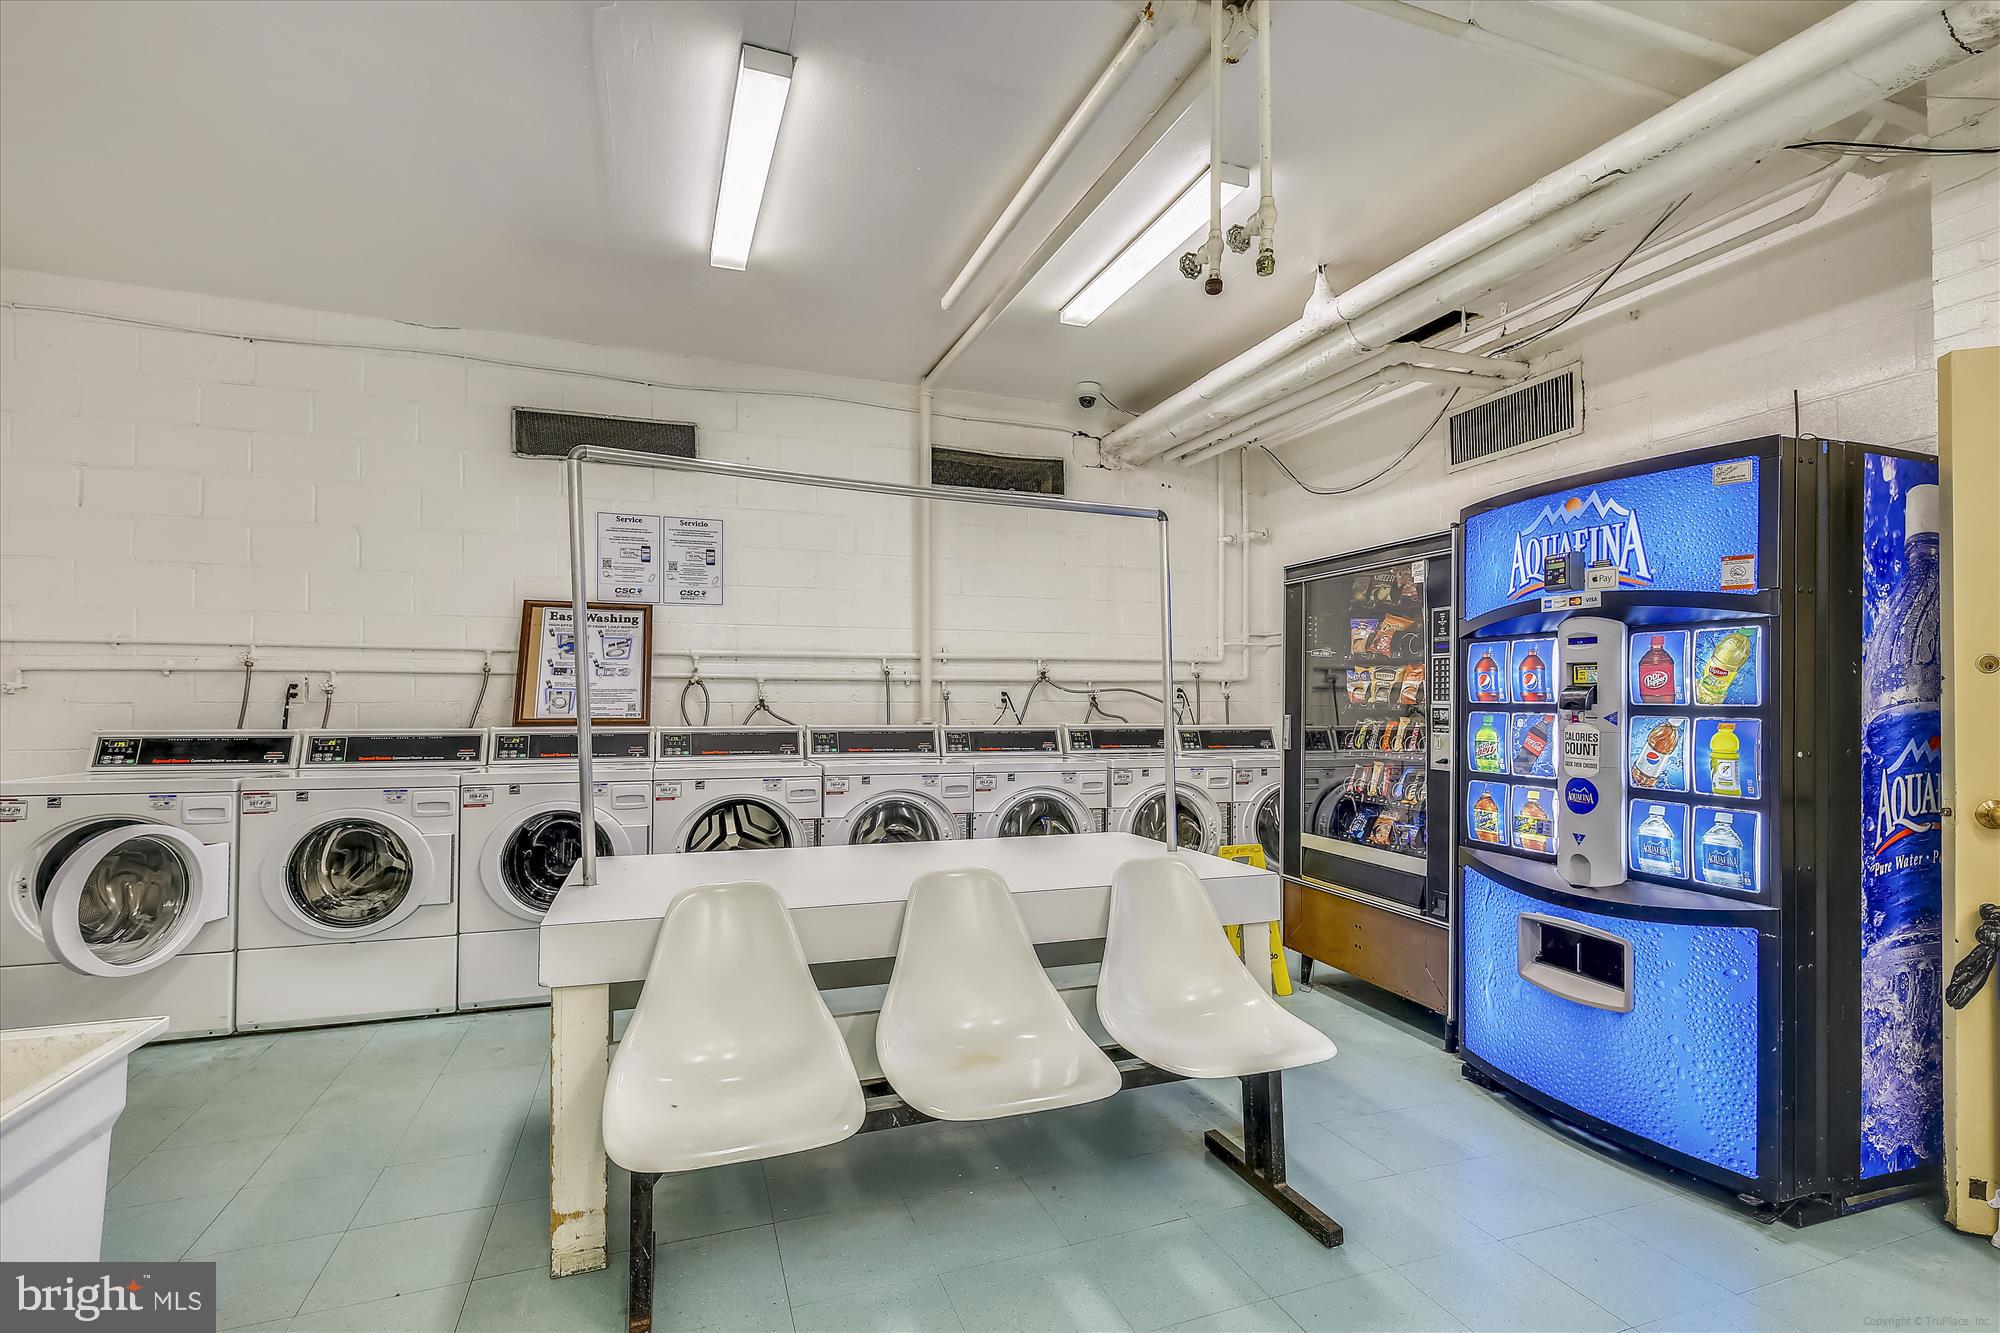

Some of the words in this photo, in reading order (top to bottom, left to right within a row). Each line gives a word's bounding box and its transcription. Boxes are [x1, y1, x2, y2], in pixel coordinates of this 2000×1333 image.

[615, 515, 643, 524] Service
[679, 519, 709, 528] Servicio
[1507, 510, 1652, 596] AQUAFINA
[1599, 574, 1613, 583] Pay
[679, 589, 701, 597] CSC
[549, 611, 574, 621] Eas
[586, 613, 640, 626] Washing
[1652, 672, 1662, 680] Dr
[1708, 666, 1728, 677] Lipton
[1645, 674, 1668, 688] Pepper
[1564, 731, 1599, 743] CALORIES
[1564, 741, 1599, 757] COUNT
[1567, 789, 1594, 805] AQUAFINA
[1643, 843, 1669, 857] AQUAFINA
[1708, 852, 1738, 869] AQUAFINA
[1874, 860, 1892, 877] Pure
[1895, 854, 1923, 870] Water
